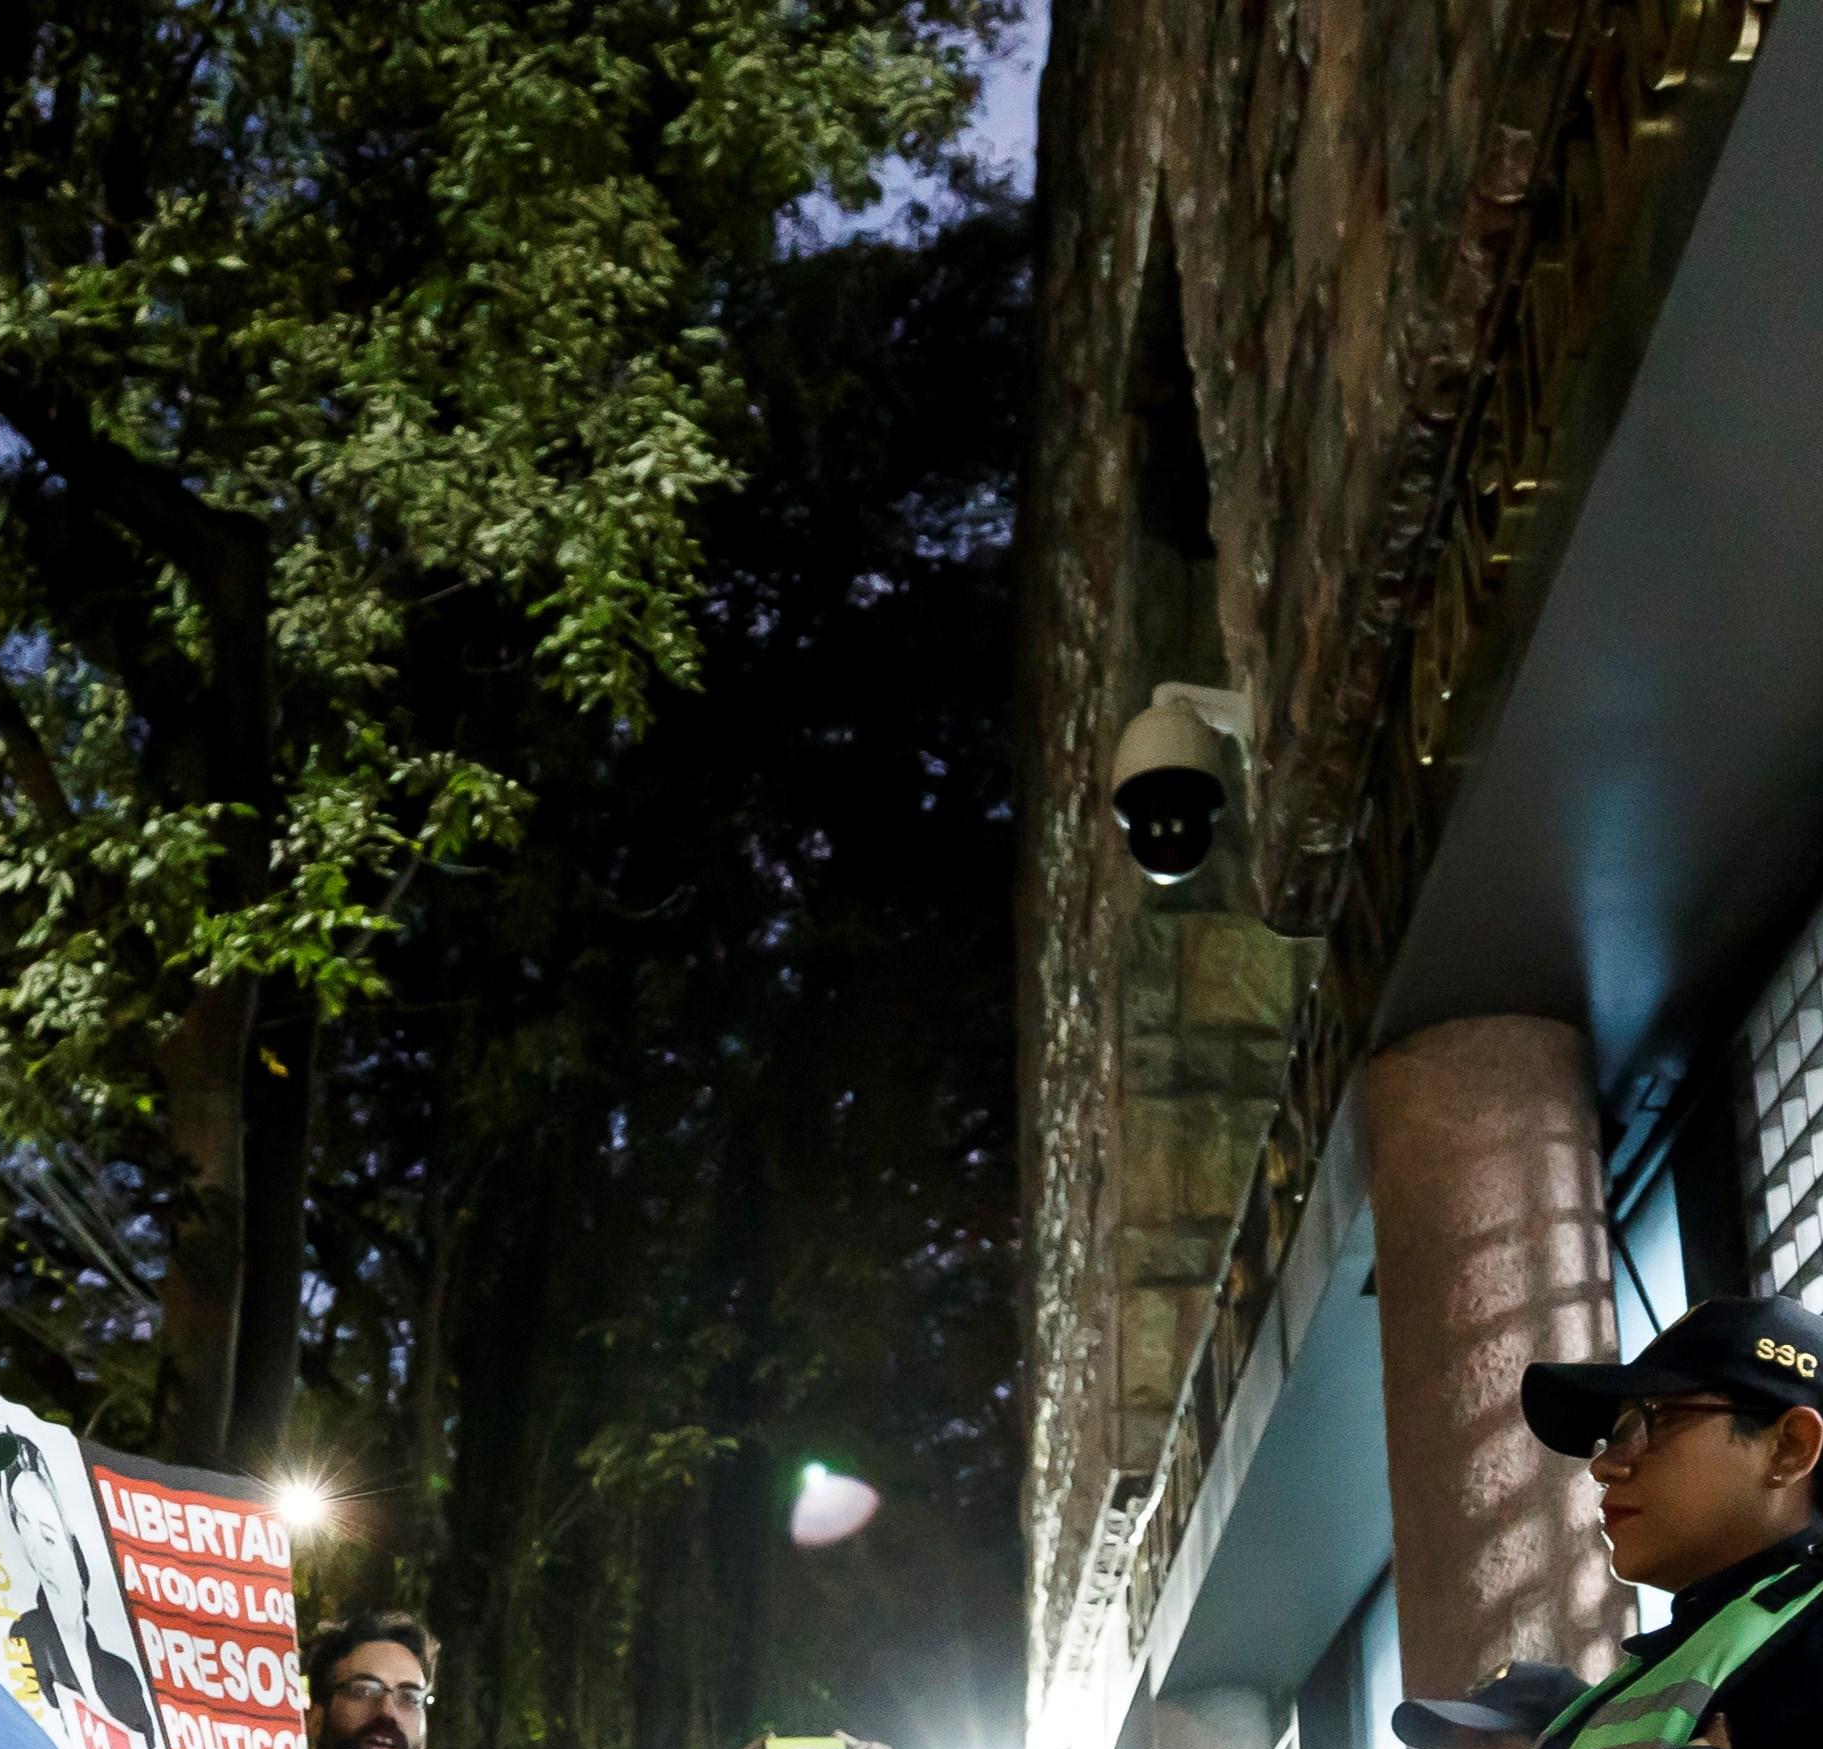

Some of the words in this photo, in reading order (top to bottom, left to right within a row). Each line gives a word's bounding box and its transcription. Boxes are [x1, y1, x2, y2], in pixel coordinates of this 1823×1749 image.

[1756, 1338, 1818, 1378] SSC
[98, 1479, 292, 1569] LIBERTAD
[243, 1584, 296, 1631] LOS
[138, 1618, 301, 1712] PRESOS
